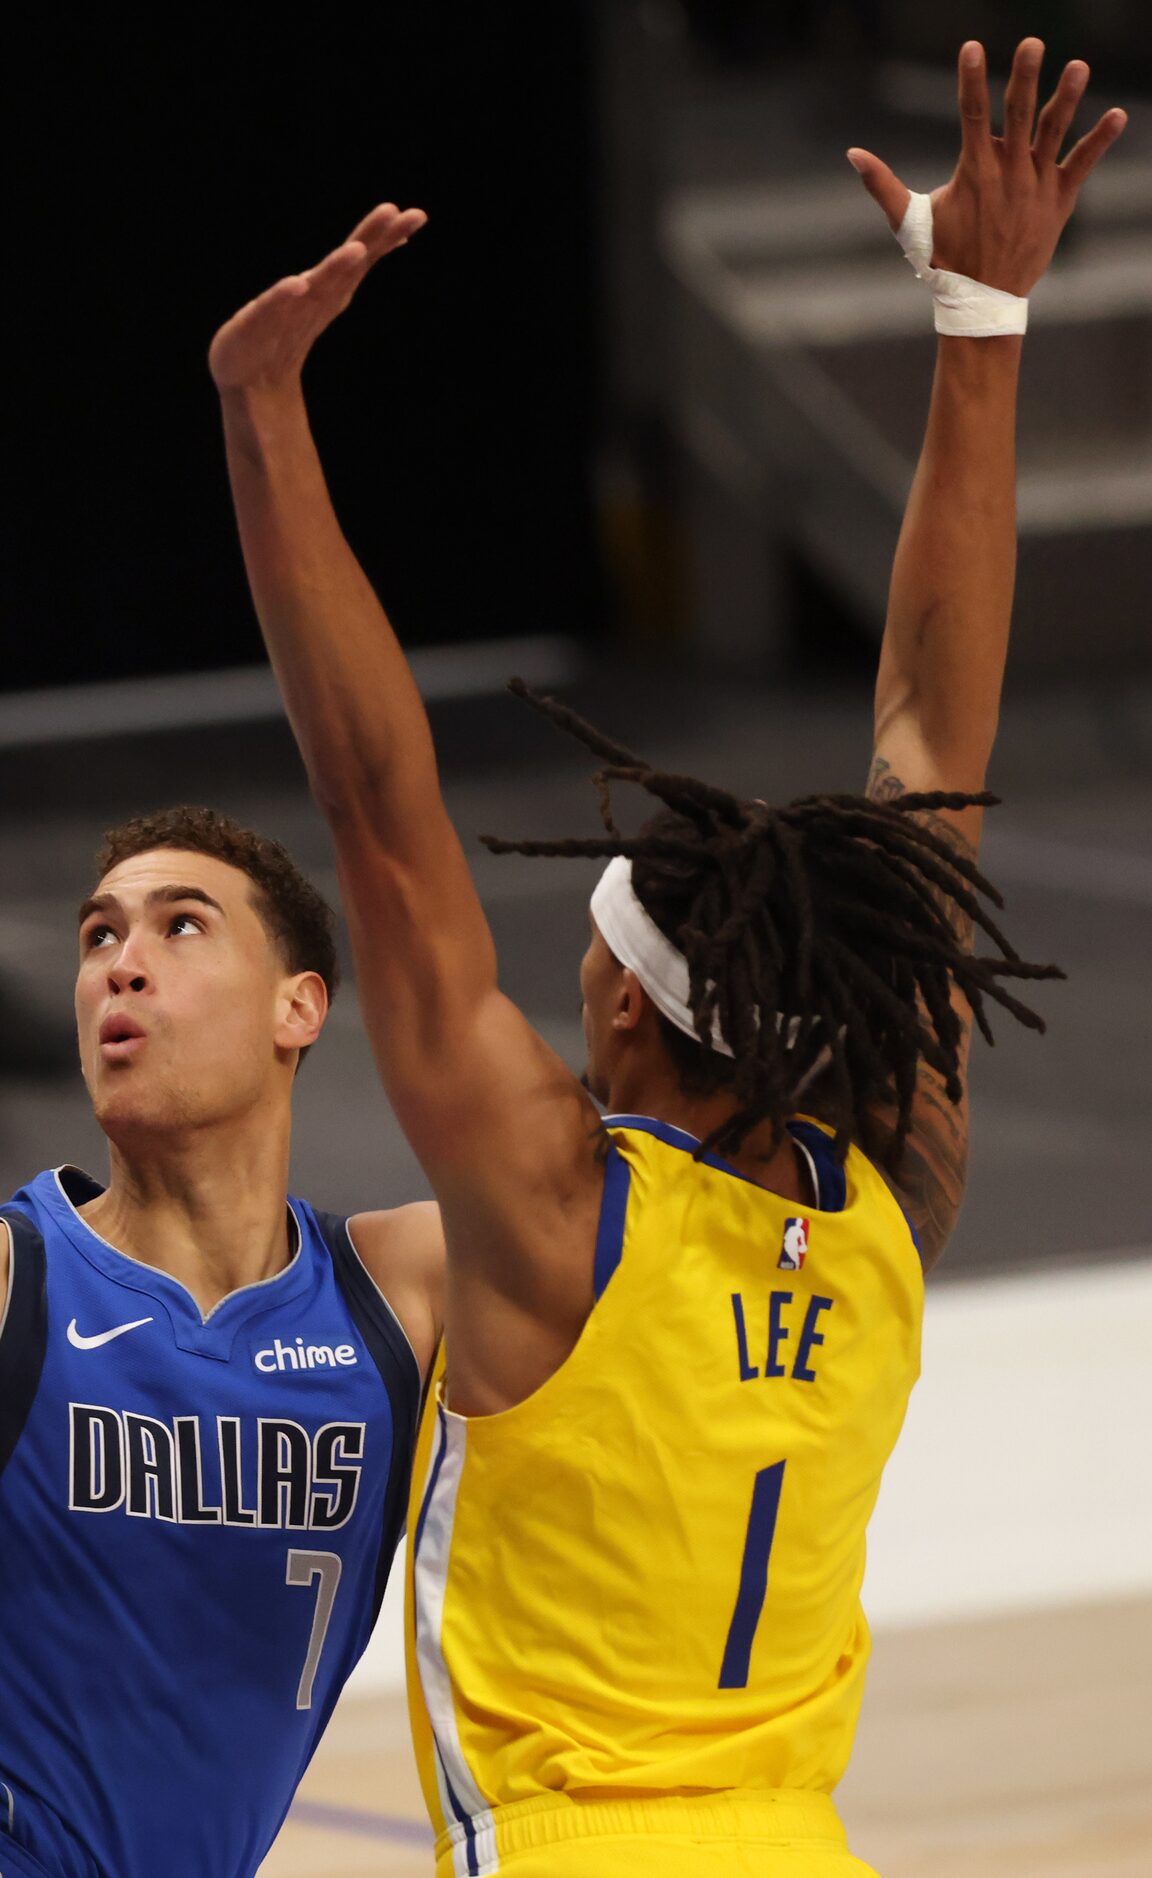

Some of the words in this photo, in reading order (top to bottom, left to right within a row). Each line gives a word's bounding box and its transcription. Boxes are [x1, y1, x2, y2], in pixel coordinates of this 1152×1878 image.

[254, 1337, 358, 1373] chime
[731, 1290, 834, 1383] LEE
[68, 1402, 366, 1531] DALLAS
[285, 1548, 342, 1710] 7
[717, 1458, 787, 1690] 1
